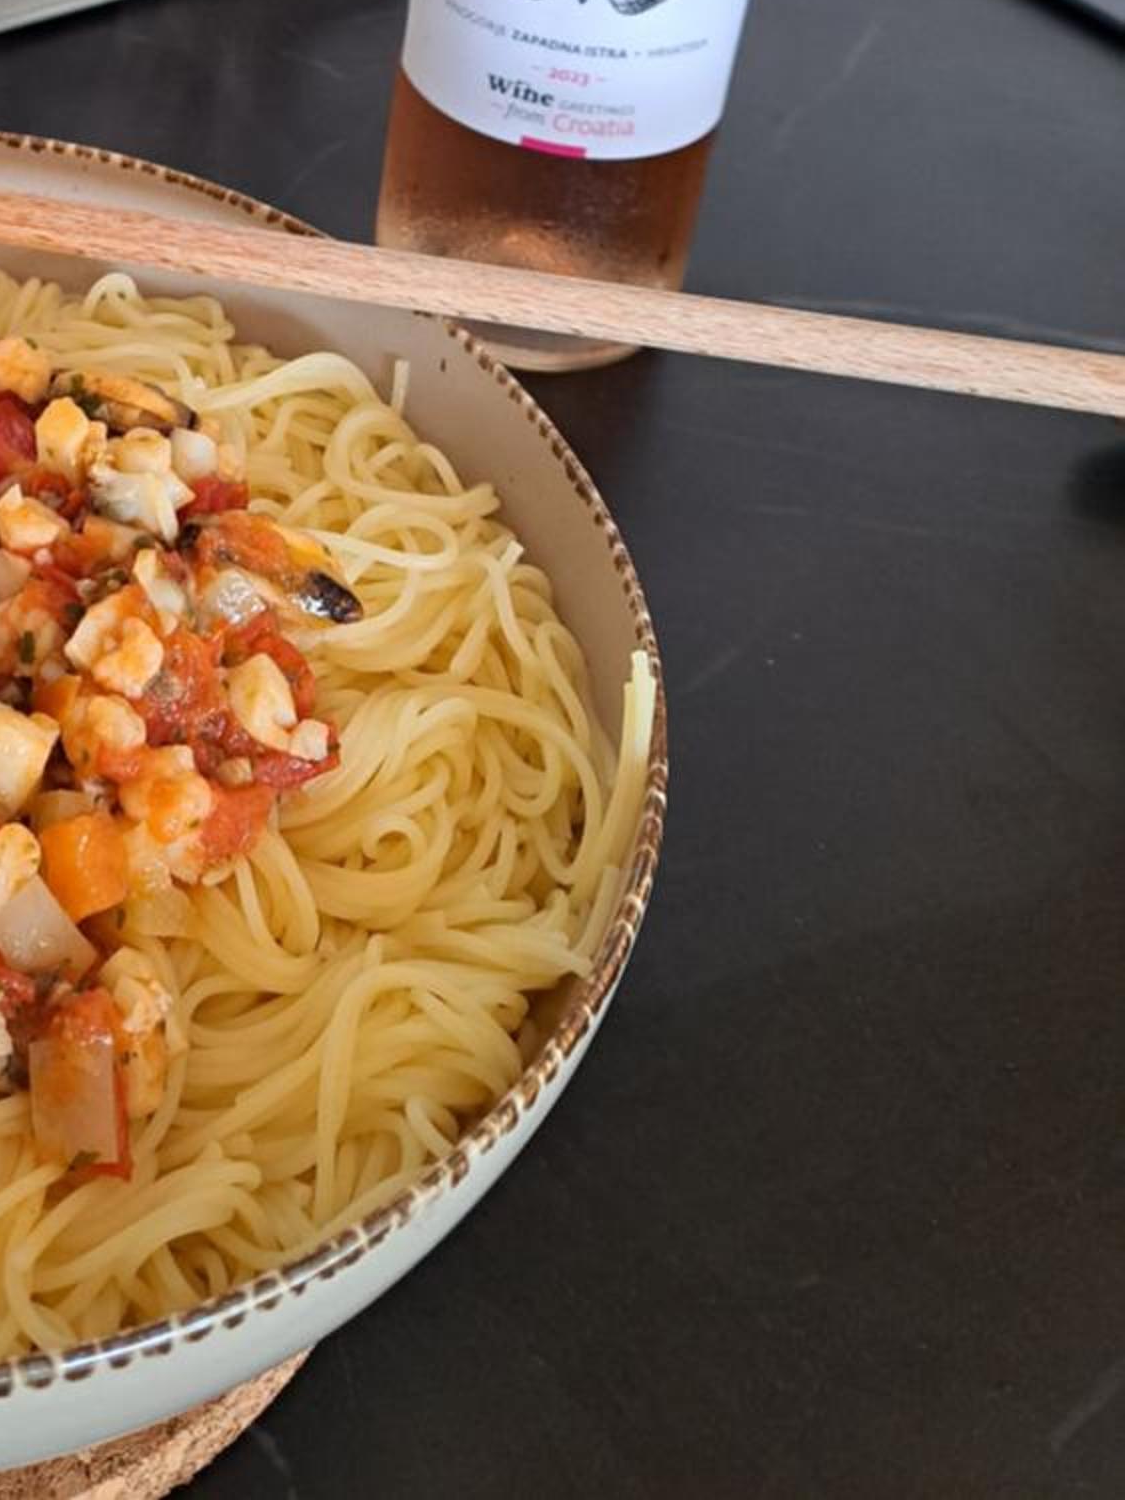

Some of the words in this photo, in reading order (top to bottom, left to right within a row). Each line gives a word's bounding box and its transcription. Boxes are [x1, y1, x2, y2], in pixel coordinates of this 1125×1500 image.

[511, 28, 581, 55] ZAPADNA
[584, 46, 628, 59] ISTRA
[487, 72, 555, 107] Wine
[504, 102, 545, 127] from
[551, 112, 635, 138] Croatia
